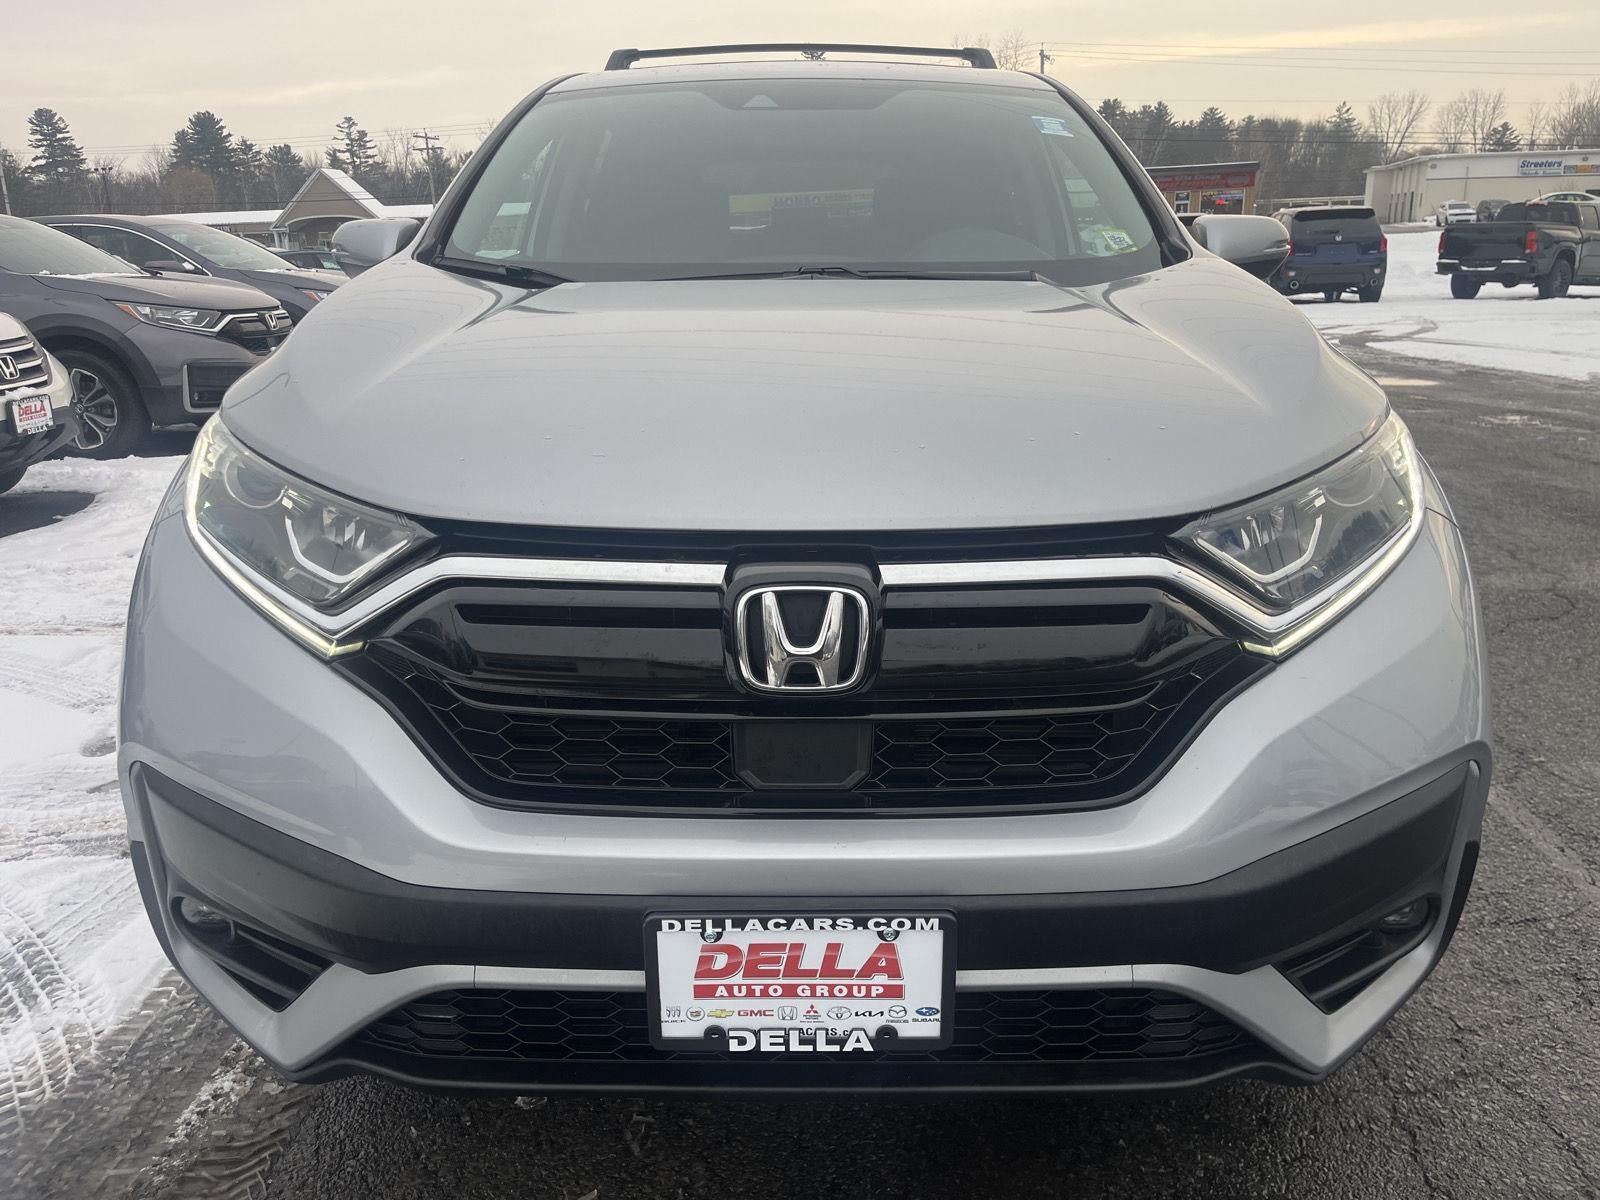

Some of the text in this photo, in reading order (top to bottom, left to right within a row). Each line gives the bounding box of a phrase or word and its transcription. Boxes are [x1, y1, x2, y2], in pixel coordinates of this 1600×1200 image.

[1520, 160, 1562, 168] Streeters
[19, 403, 46, 417] DELLA
[28, 425, 47, 434] DELLA
[660, 918, 940, 933] DELLACARS.COM
[694, 942, 904, 981] DELLA
[714, 984, 885, 998] AUTO GROUP
[737, 1009, 775, 1018] GMC
[728, 1029, 875, 1052] DELLA
